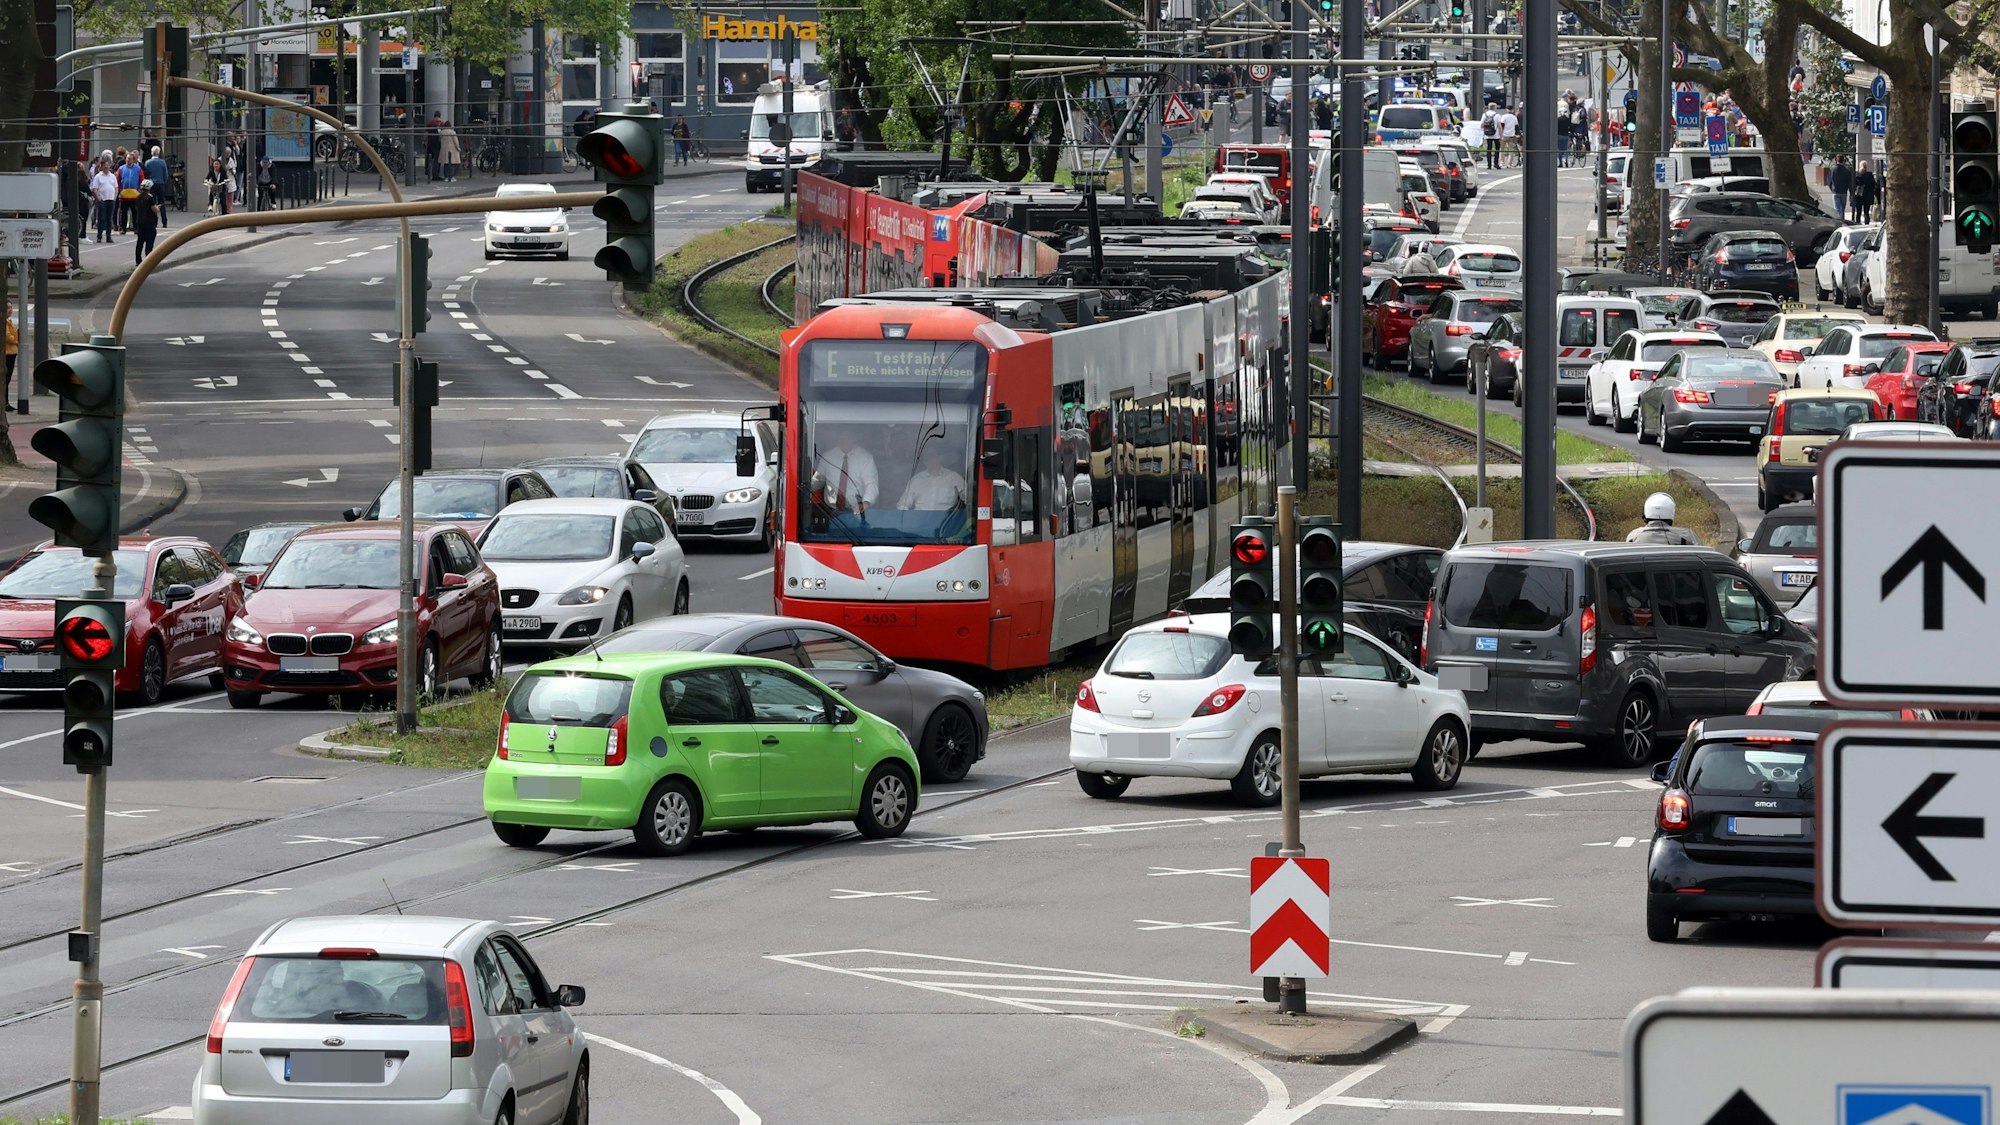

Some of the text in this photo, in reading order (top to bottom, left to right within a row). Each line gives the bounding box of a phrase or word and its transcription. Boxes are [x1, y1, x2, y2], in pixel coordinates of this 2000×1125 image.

[1254, 65, 1266, 75] 30
[1848, 106, 1857, 120] P
[1678, 116, 1698, 125] TAXI
[1873, 109, 1883, 131] P
[1710, 143, 1727, 153] TAXI
[874, 352, 946, 365] Testfahrt
[827, 351, 837, 378] E
[847, 366, 973, 378] Bitte nicht einsteigen
[685, 513, 703, 522] 7000
[866, 567, 883, 575] KVB
[1787, 575, 1811, 583] K AB
[512, 618, 518, 628] A
[519, 618, 539, 628] 2900
[863, 613, 897, 624] 4503
[206, 614, 223, 636] Uber
